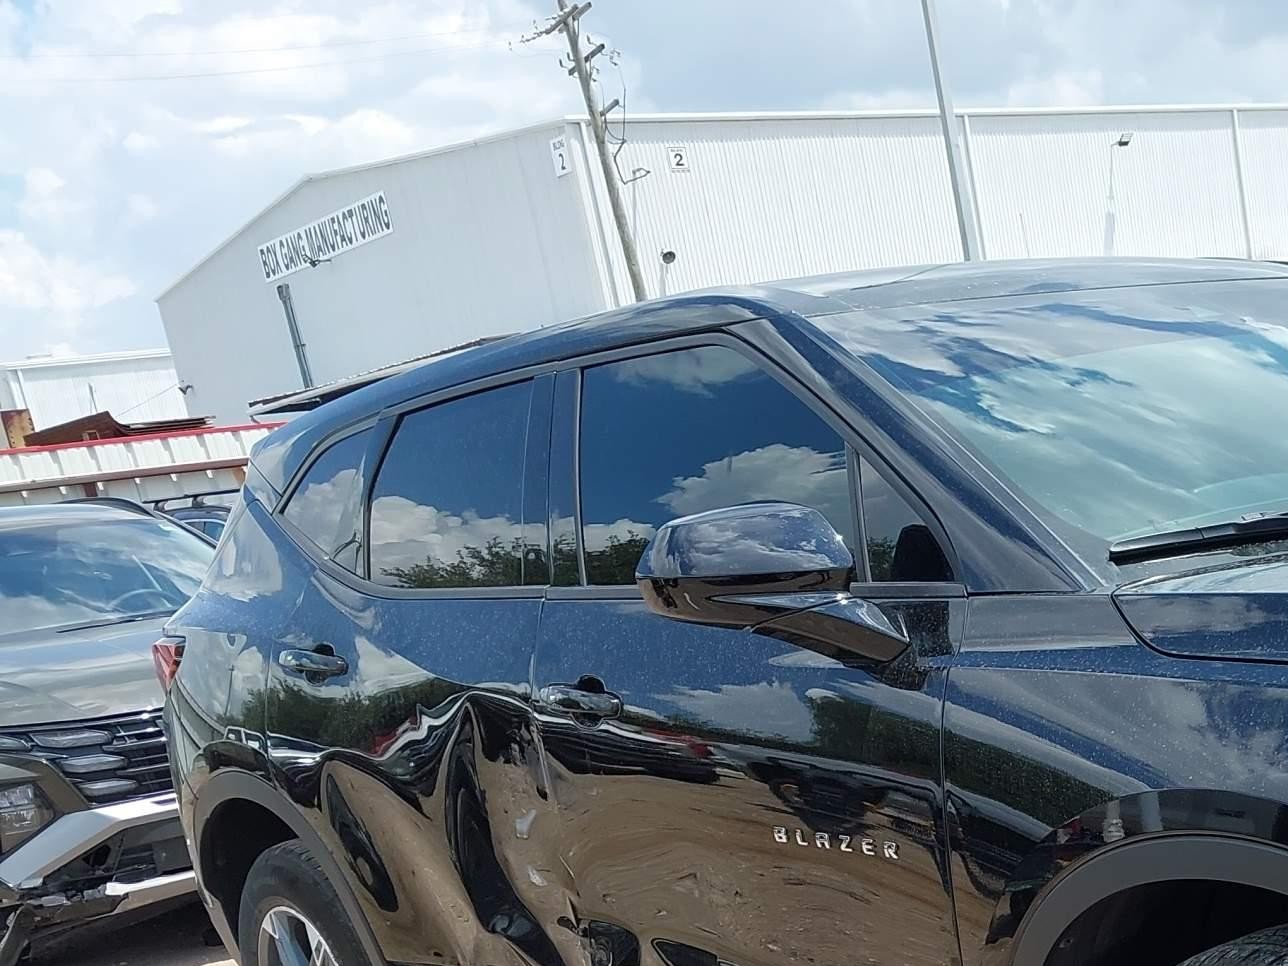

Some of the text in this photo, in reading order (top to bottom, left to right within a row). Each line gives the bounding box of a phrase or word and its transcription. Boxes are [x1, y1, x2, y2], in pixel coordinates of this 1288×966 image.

[558, 152, 567, 171] 2
[673, 152, 686, 167] 2
[259, 194, 391, 279] BOX GANG MANUFACTURING
[773, 826, 898, 859] BLAZER
